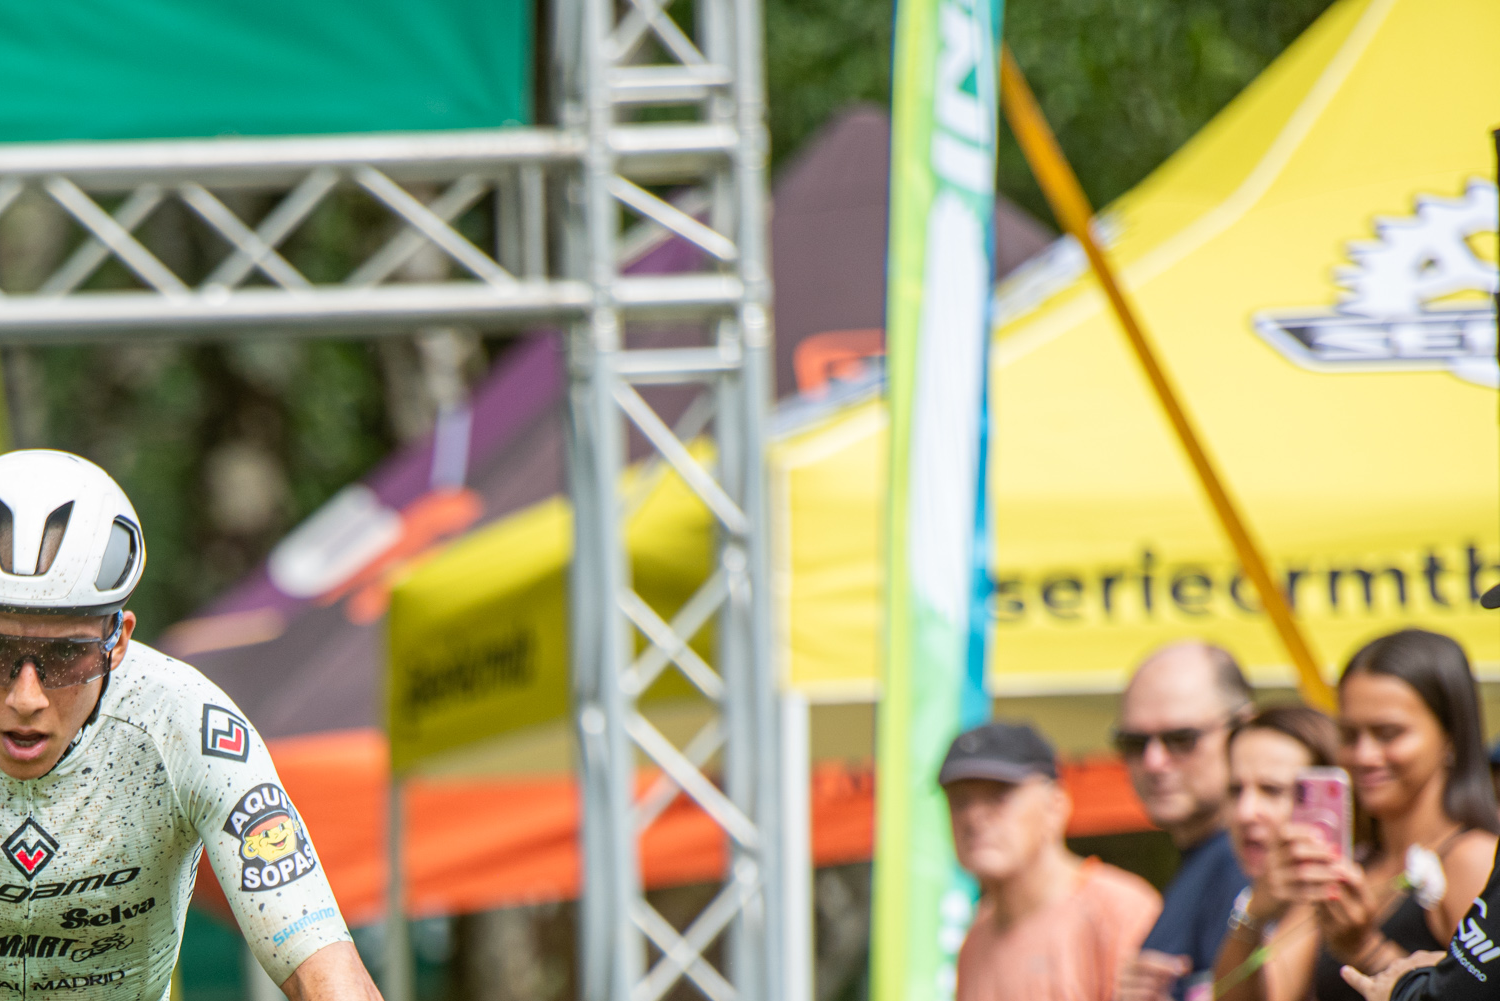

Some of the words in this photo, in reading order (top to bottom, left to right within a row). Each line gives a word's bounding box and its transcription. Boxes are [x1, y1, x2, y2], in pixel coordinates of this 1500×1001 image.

[230, 787, 288, 835] AQUI
[243, 843, 314, 889] SOPAS
[60, 897, 156, 930] Selva
[272, 906, 336, 947] SHIMANO
[33, 970, 127, 991] MADRID
